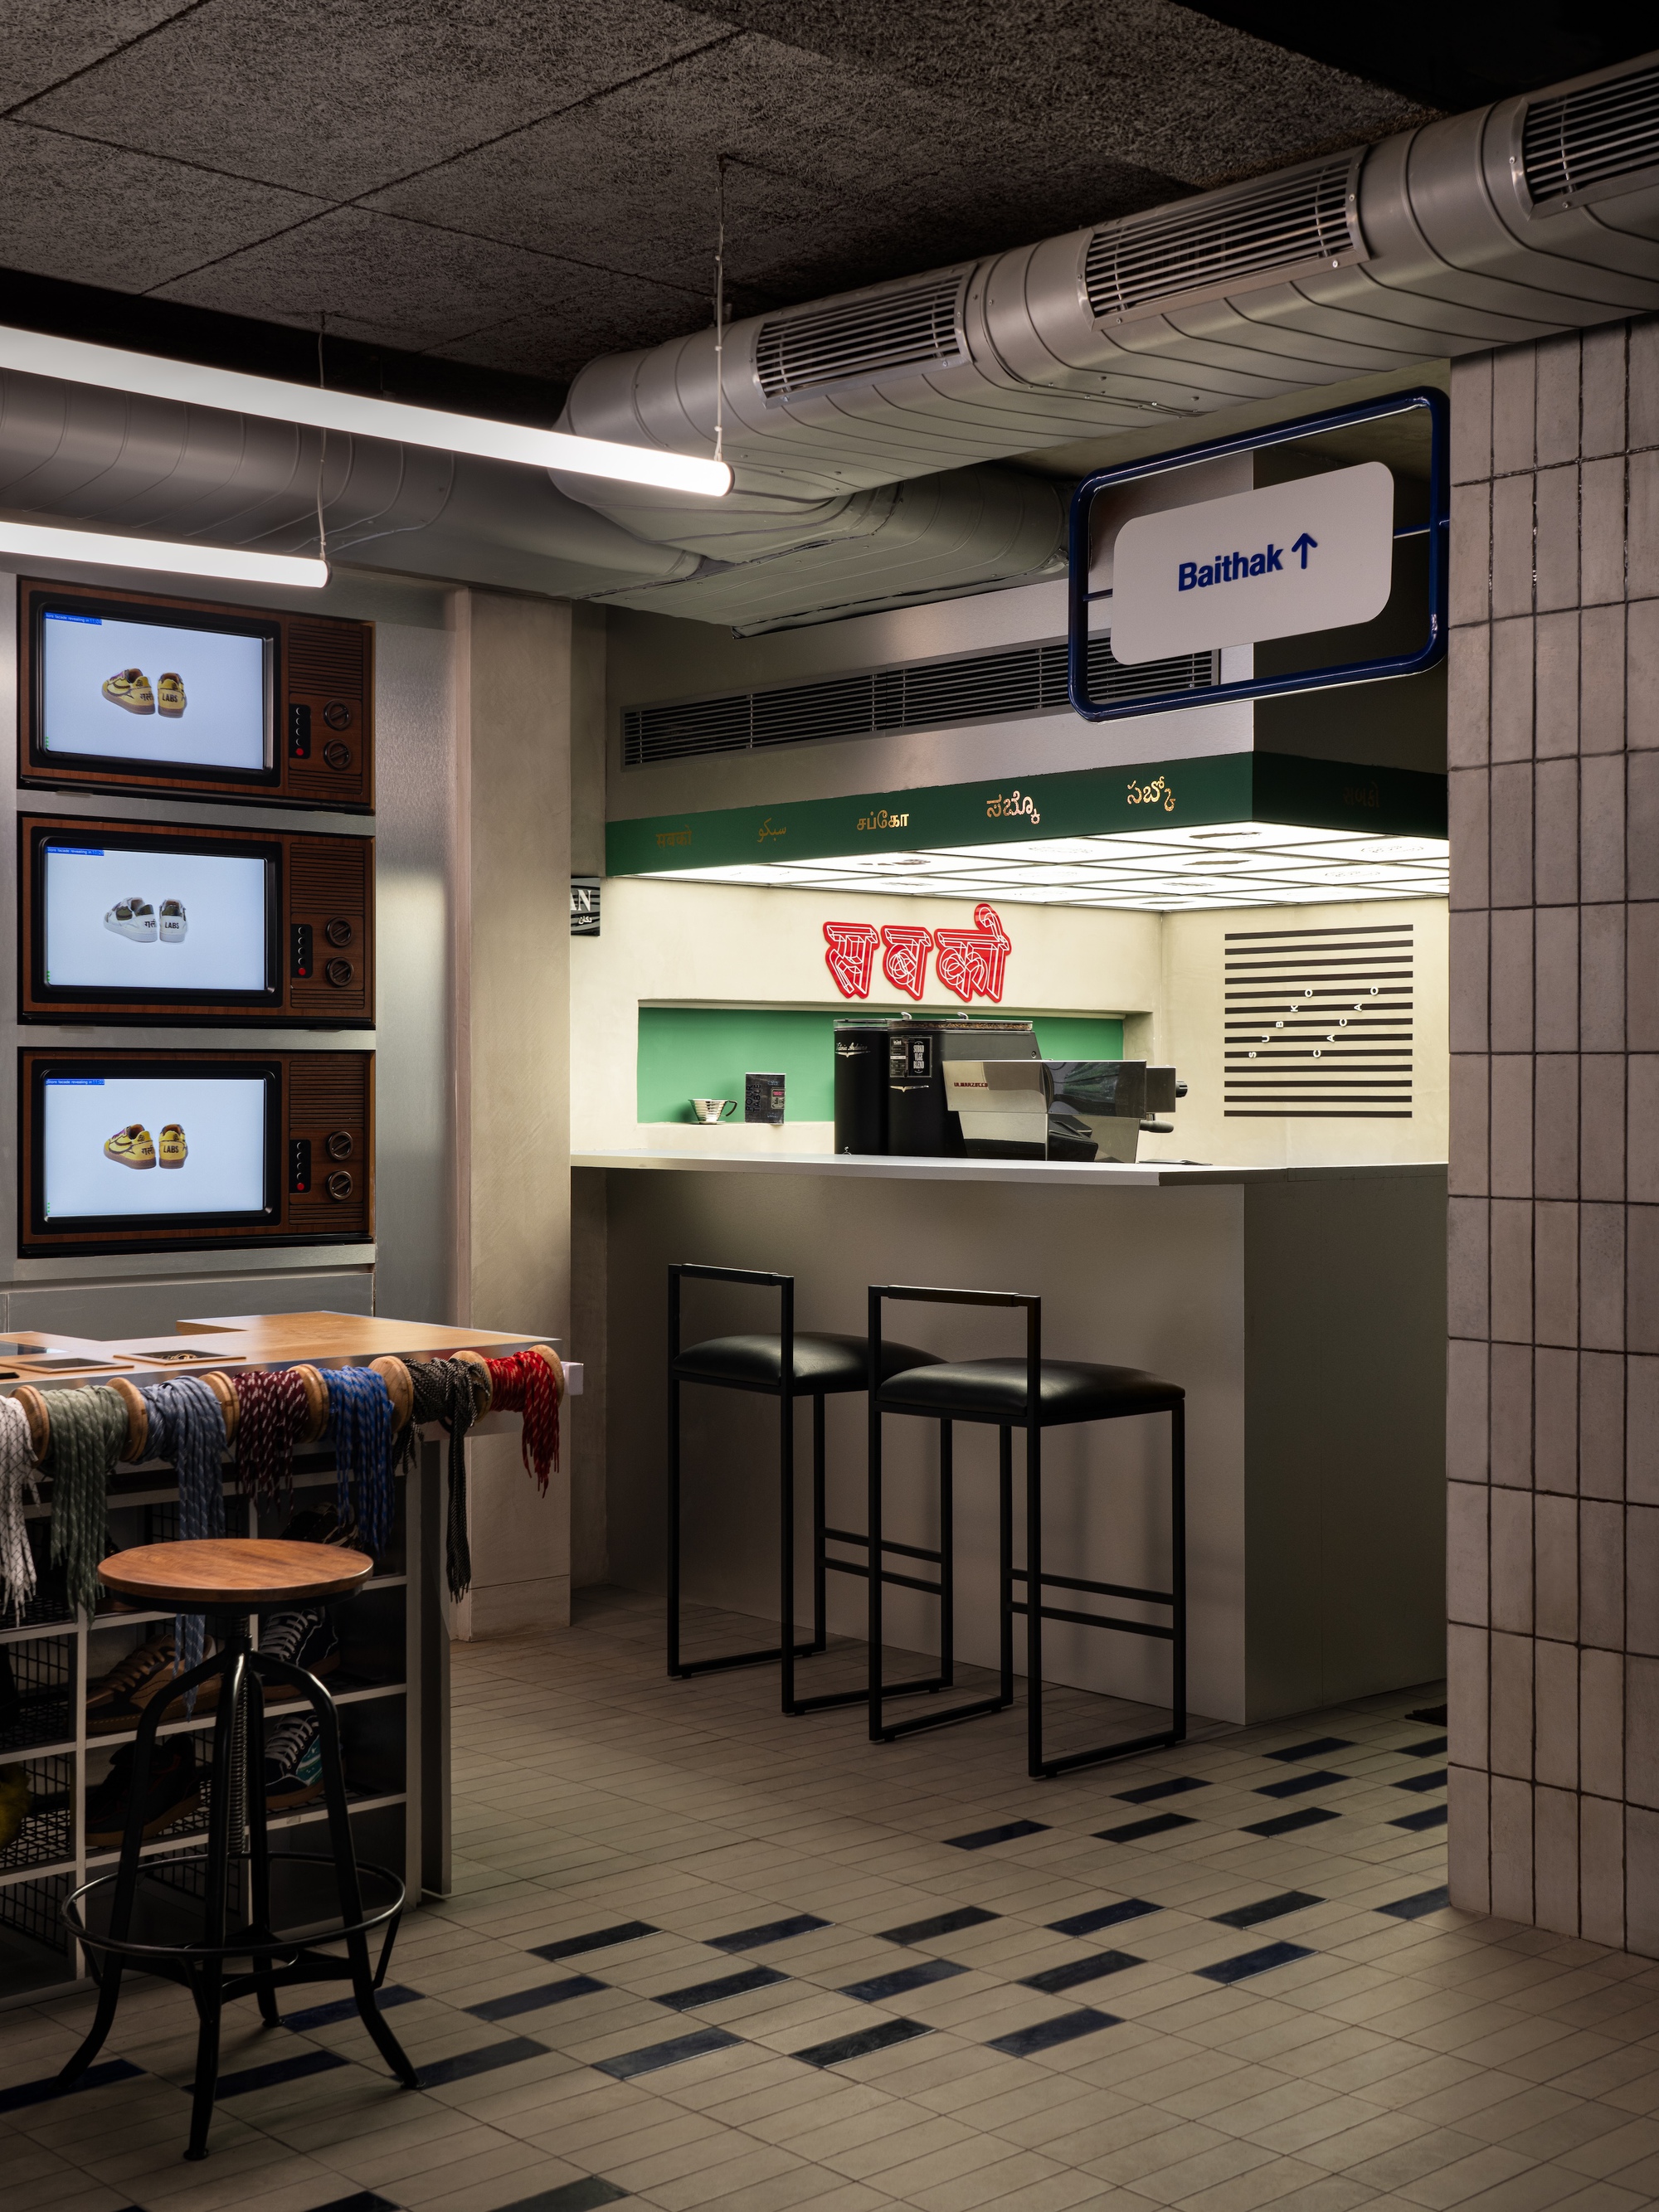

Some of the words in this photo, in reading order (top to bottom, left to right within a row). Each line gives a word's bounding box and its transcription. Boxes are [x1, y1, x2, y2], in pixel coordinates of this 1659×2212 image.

[1178, 544, 1283, 591] Baithak
[162, 693, 178, 702] LABS
[857, 809, 910, 831] சப்கோ
[655, 824, 693, 848] सबको
[823, 903, 1012, 1003] सबको
[753, 1084, 761, 1112] TABLE
[163, 1145, 179, 1154] LABS
